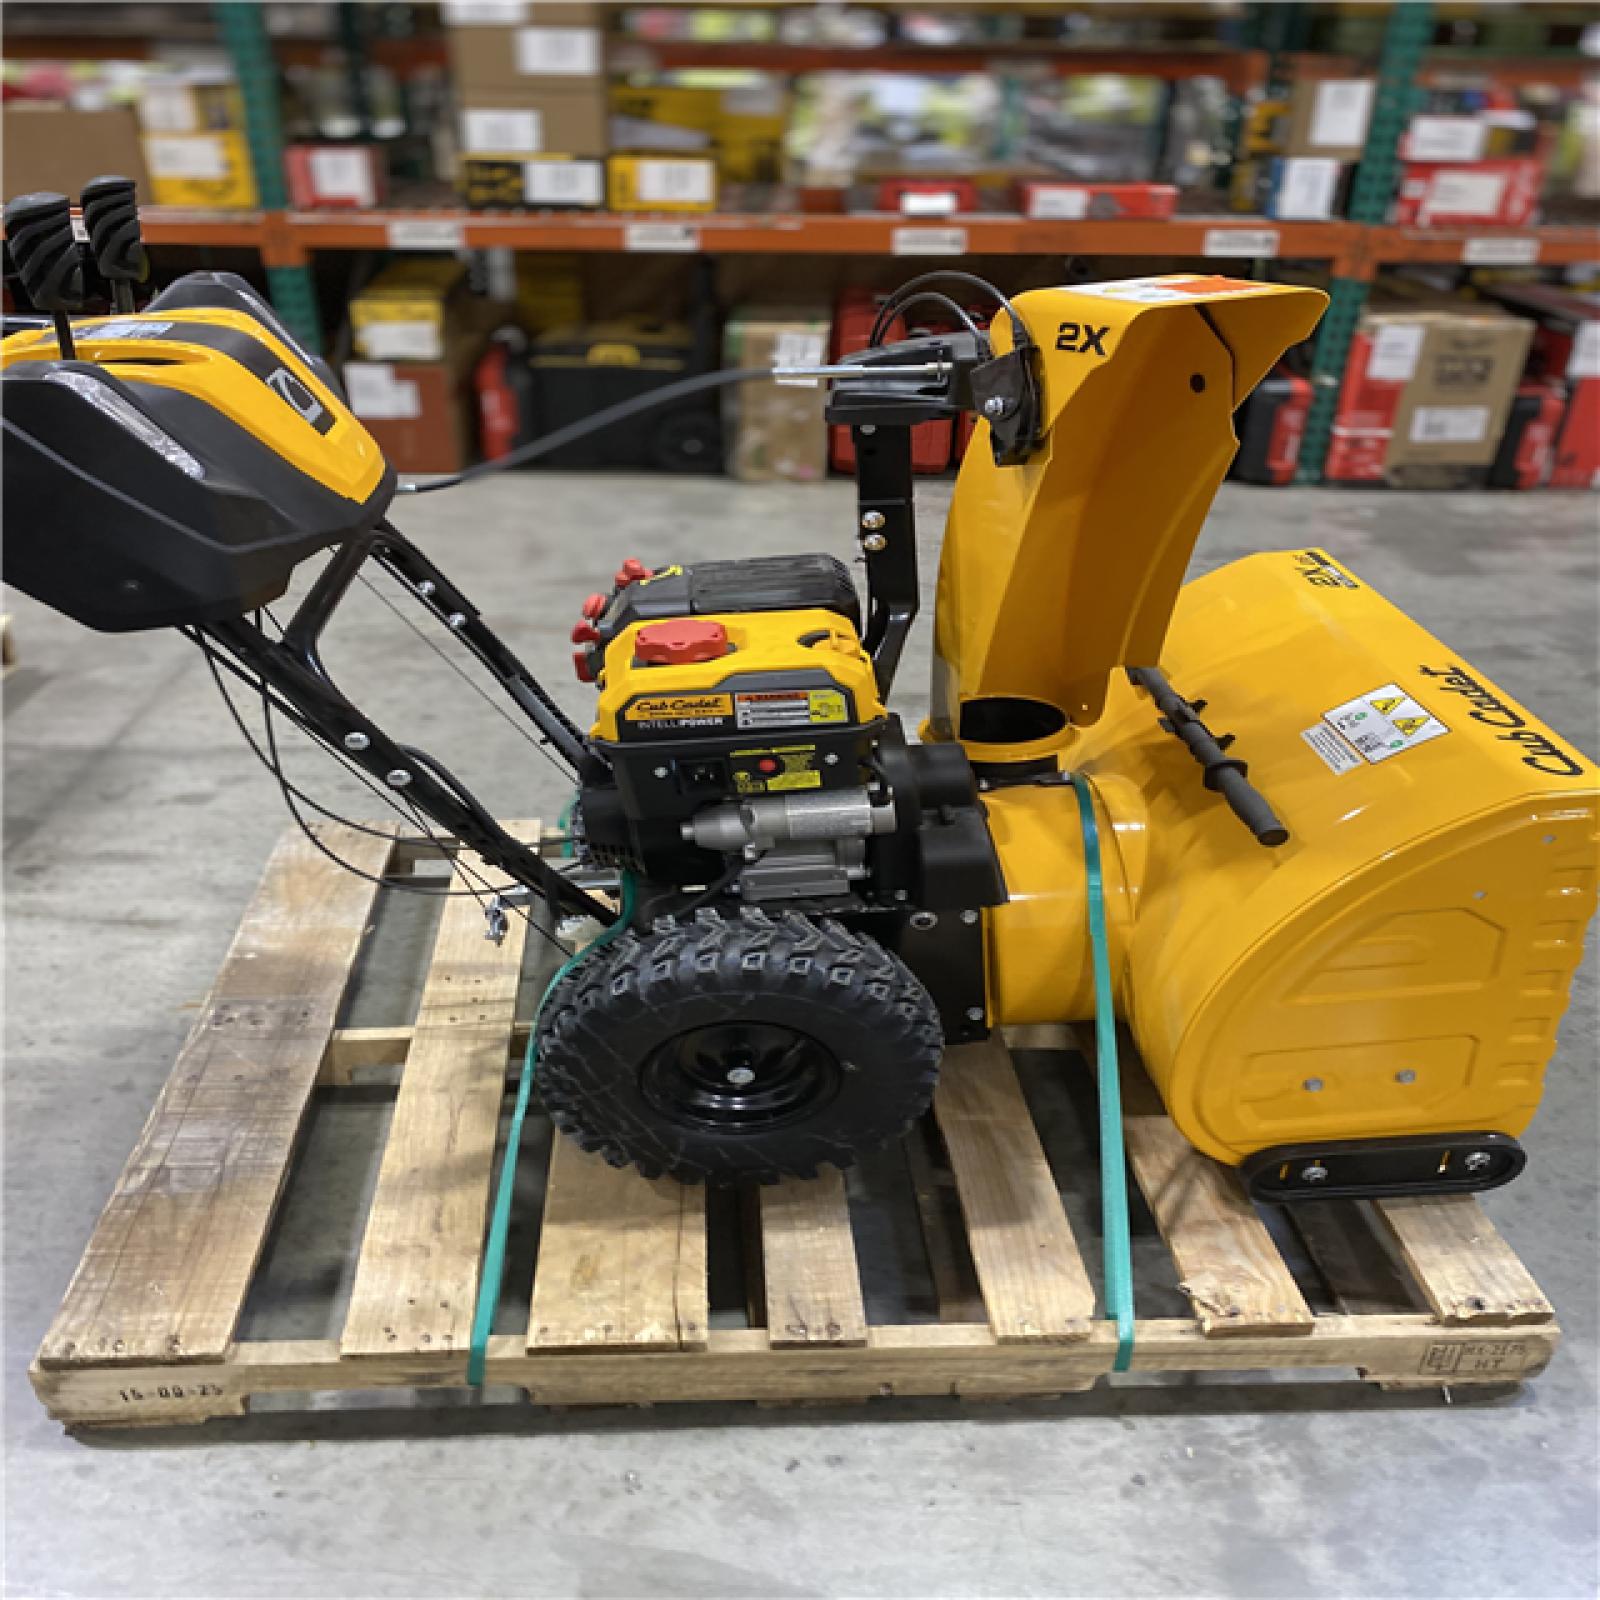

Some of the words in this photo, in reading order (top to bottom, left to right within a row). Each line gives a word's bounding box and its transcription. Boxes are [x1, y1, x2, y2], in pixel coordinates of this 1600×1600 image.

[1055, 322, 1110, 356] 2X
[635, 699, 668, 711] Cub
[670, 697, 723, 710] Cadet
[1419, 664, 1525, 727] Cadet
[1495, 730, 1583, 775] Cub
